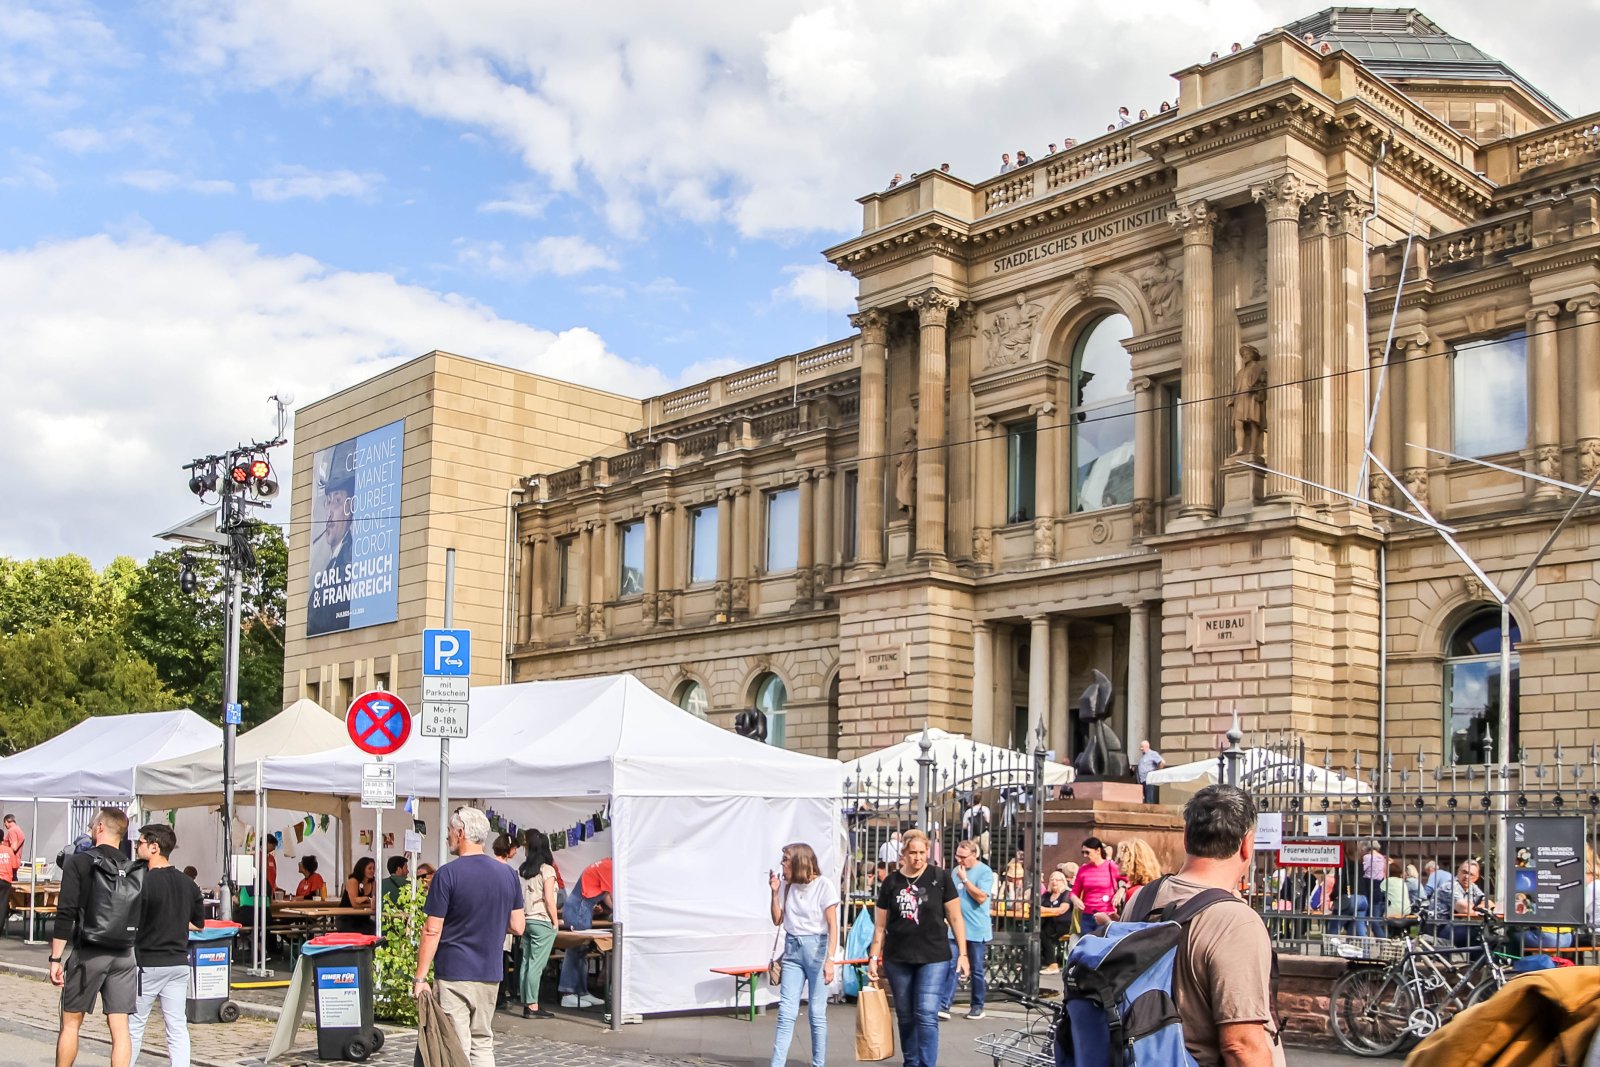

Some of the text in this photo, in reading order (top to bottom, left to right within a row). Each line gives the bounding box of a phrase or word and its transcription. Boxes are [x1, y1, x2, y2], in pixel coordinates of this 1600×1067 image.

[994, 236, 1077, 273] STAEDELSCHES
[356, 460, 395, 489] MANET
[344, 483, 395, 516] COURBET
[353, 506, 394, 535] MONET
[355, 530, 392, 557] COROT
[314, 554, 392, 588] CARL SCHUCH
[313, 574, 391, 608] & FRANKREICH
[1206, 618, 1244, 630] NEUBAU
[434, 635, 459, 670] P
[868, 653, 897, 663] STIFTUNG
[1284, 846, 1335, 854] Feuerwehrzufahrt
